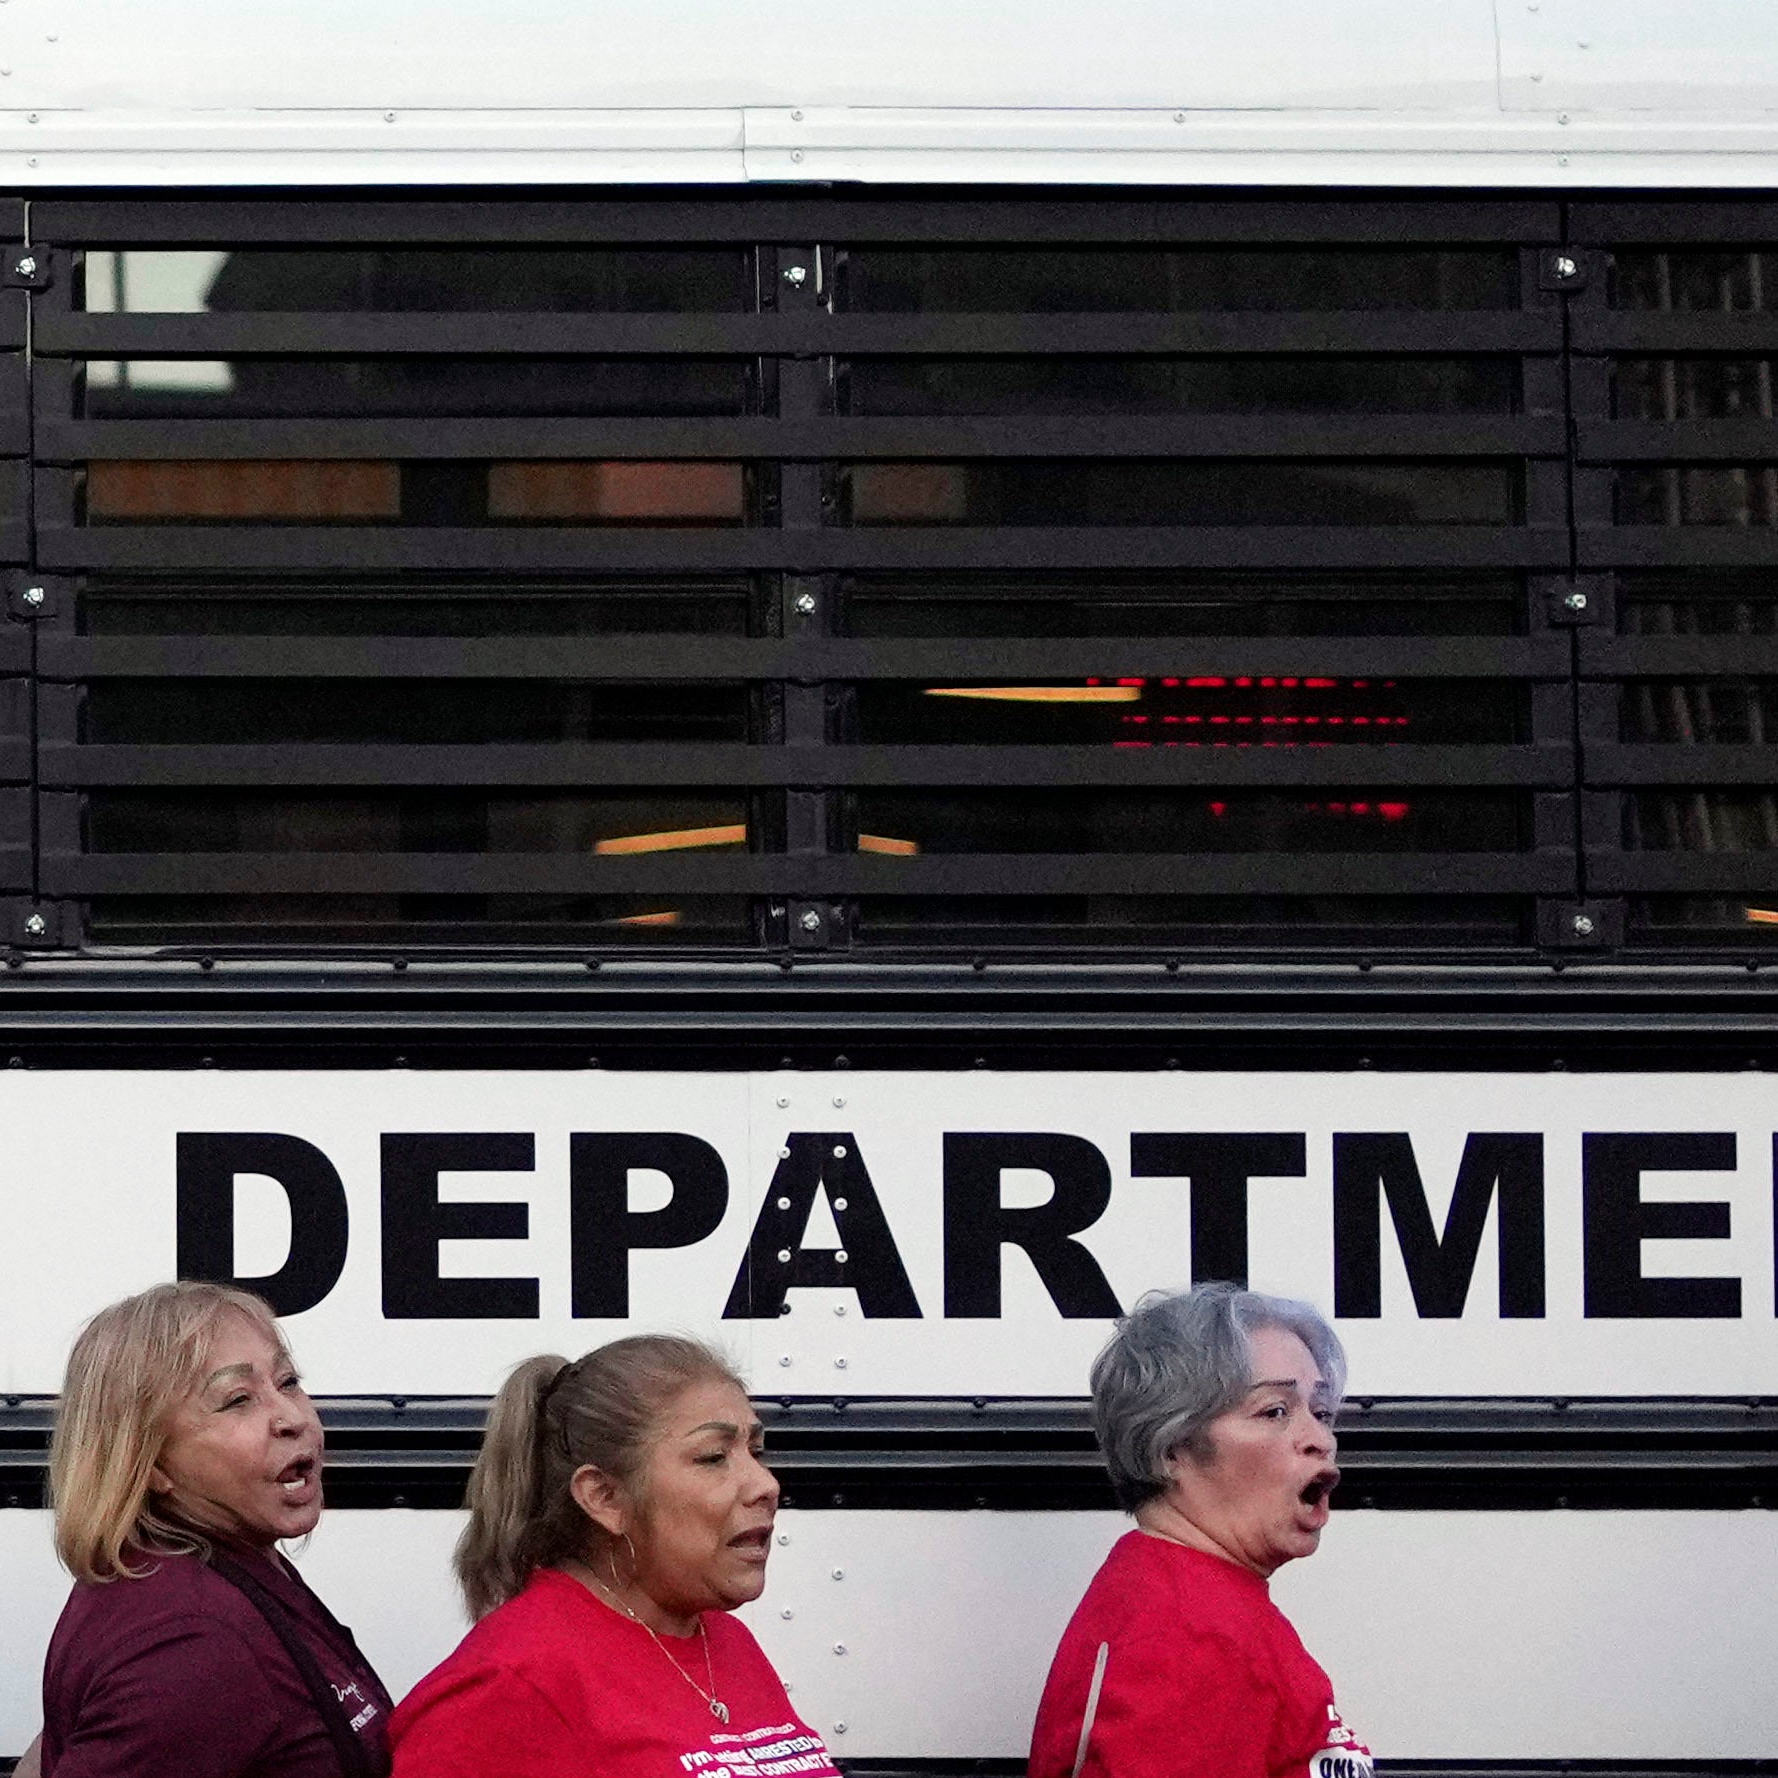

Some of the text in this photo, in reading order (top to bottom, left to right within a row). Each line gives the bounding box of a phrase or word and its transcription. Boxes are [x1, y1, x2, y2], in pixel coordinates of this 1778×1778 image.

[176, 1130, 1778, 1319] DEPARTME
[679, 1750, 714, 1771] I'm
[757, 1755, 824, 1776] CONTRACT
